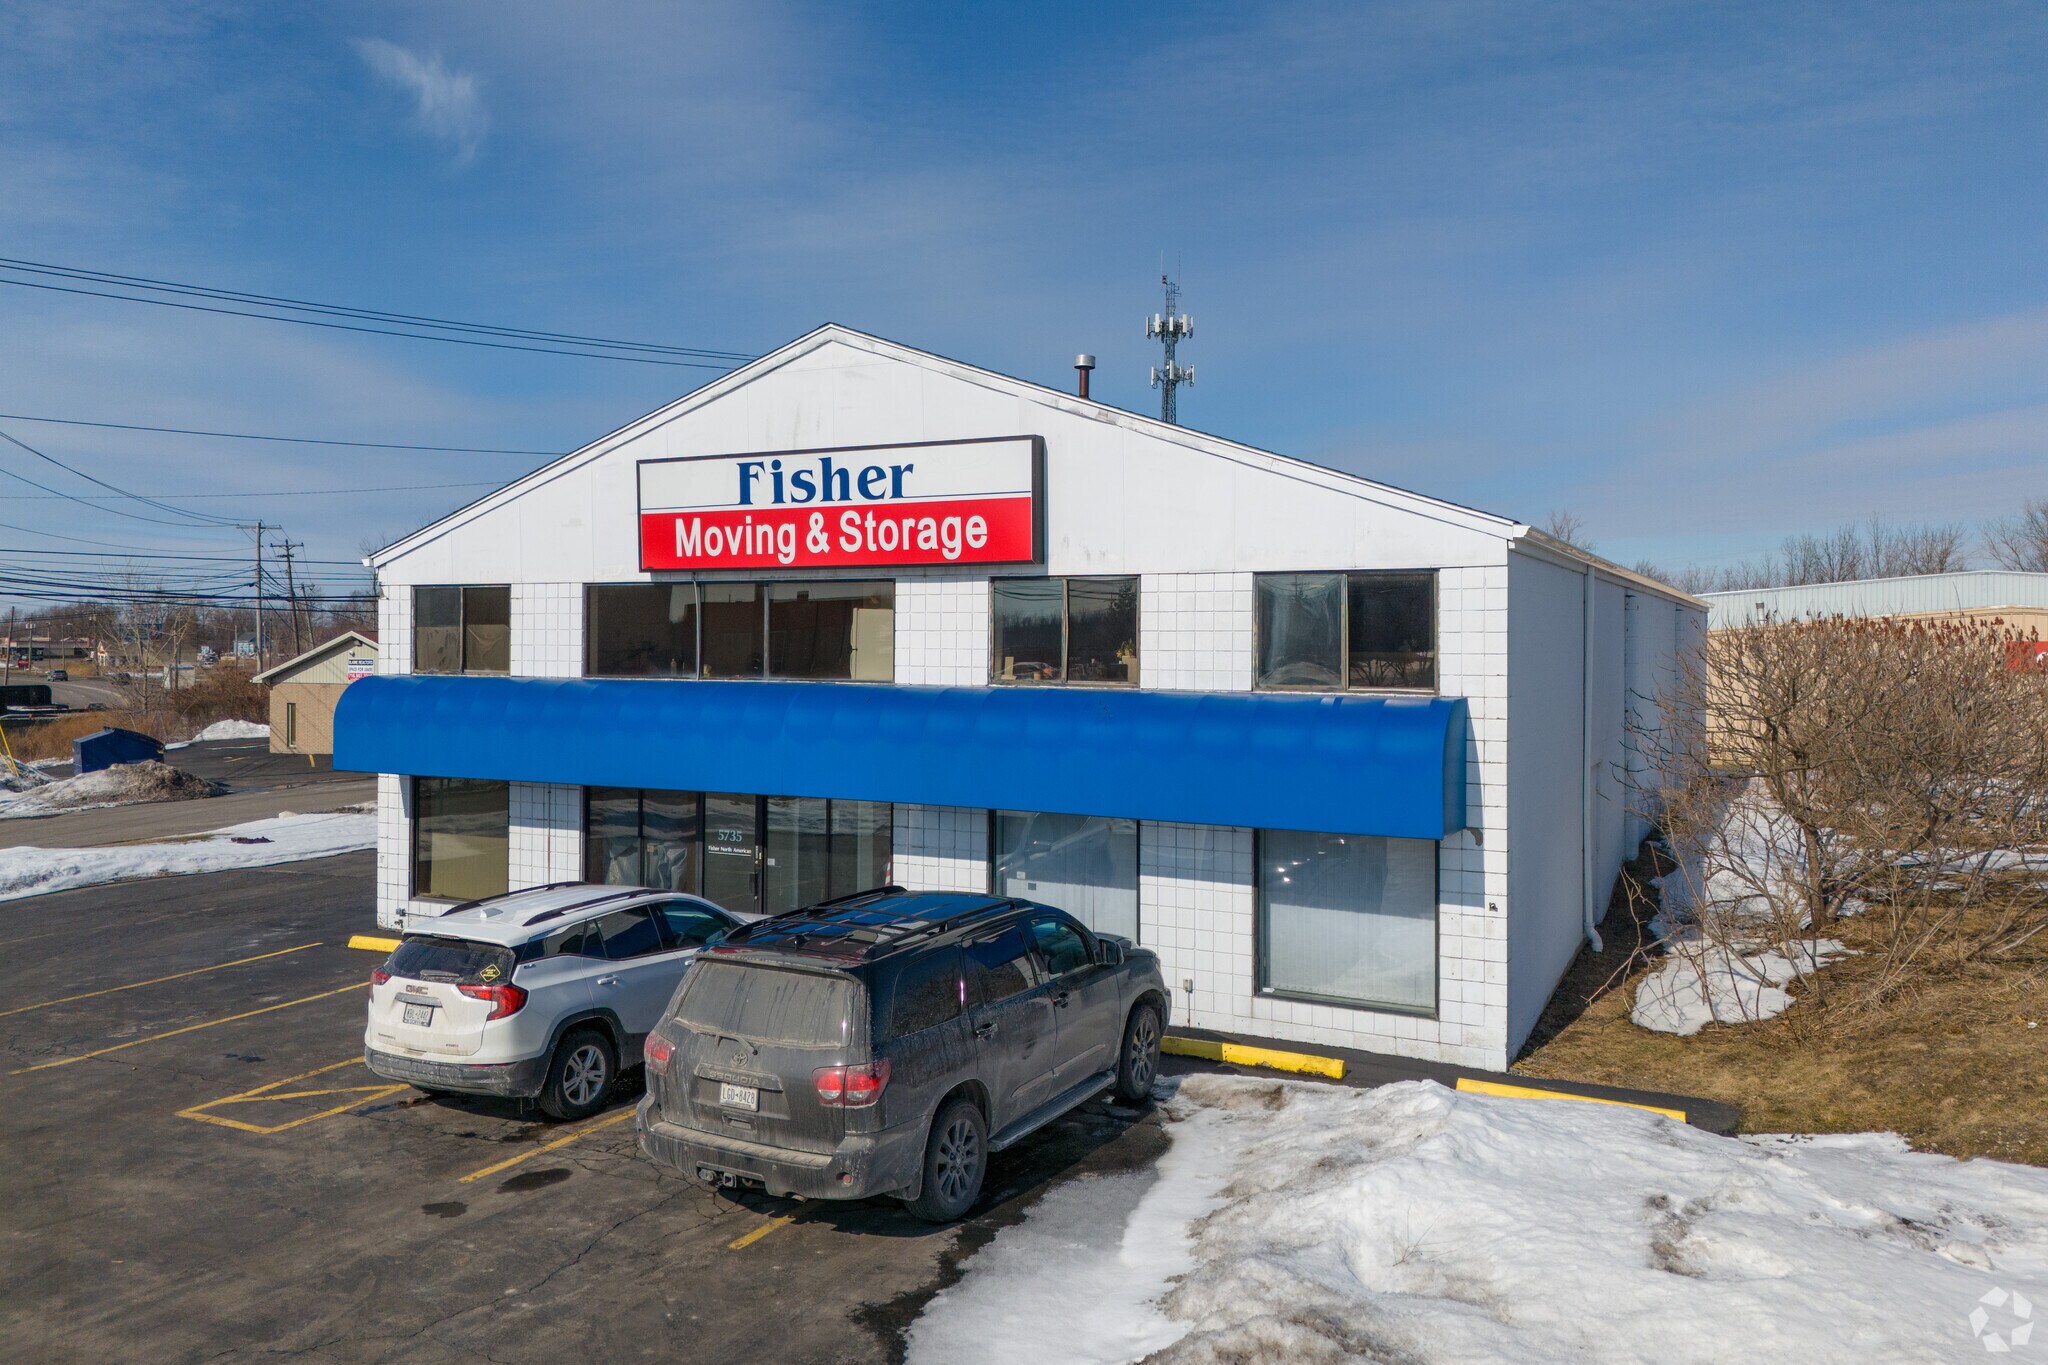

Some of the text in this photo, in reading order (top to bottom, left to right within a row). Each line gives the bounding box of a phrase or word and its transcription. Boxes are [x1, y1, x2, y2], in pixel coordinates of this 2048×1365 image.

[736, 456, 915, 506] Fisher
[675, 509, 989, 565] Moving & Storage
[717, 828, 743, 842] 5735
[405, 984, 429, 995] GMC
[709, 1070, 761, 1086] SEQUOIA
